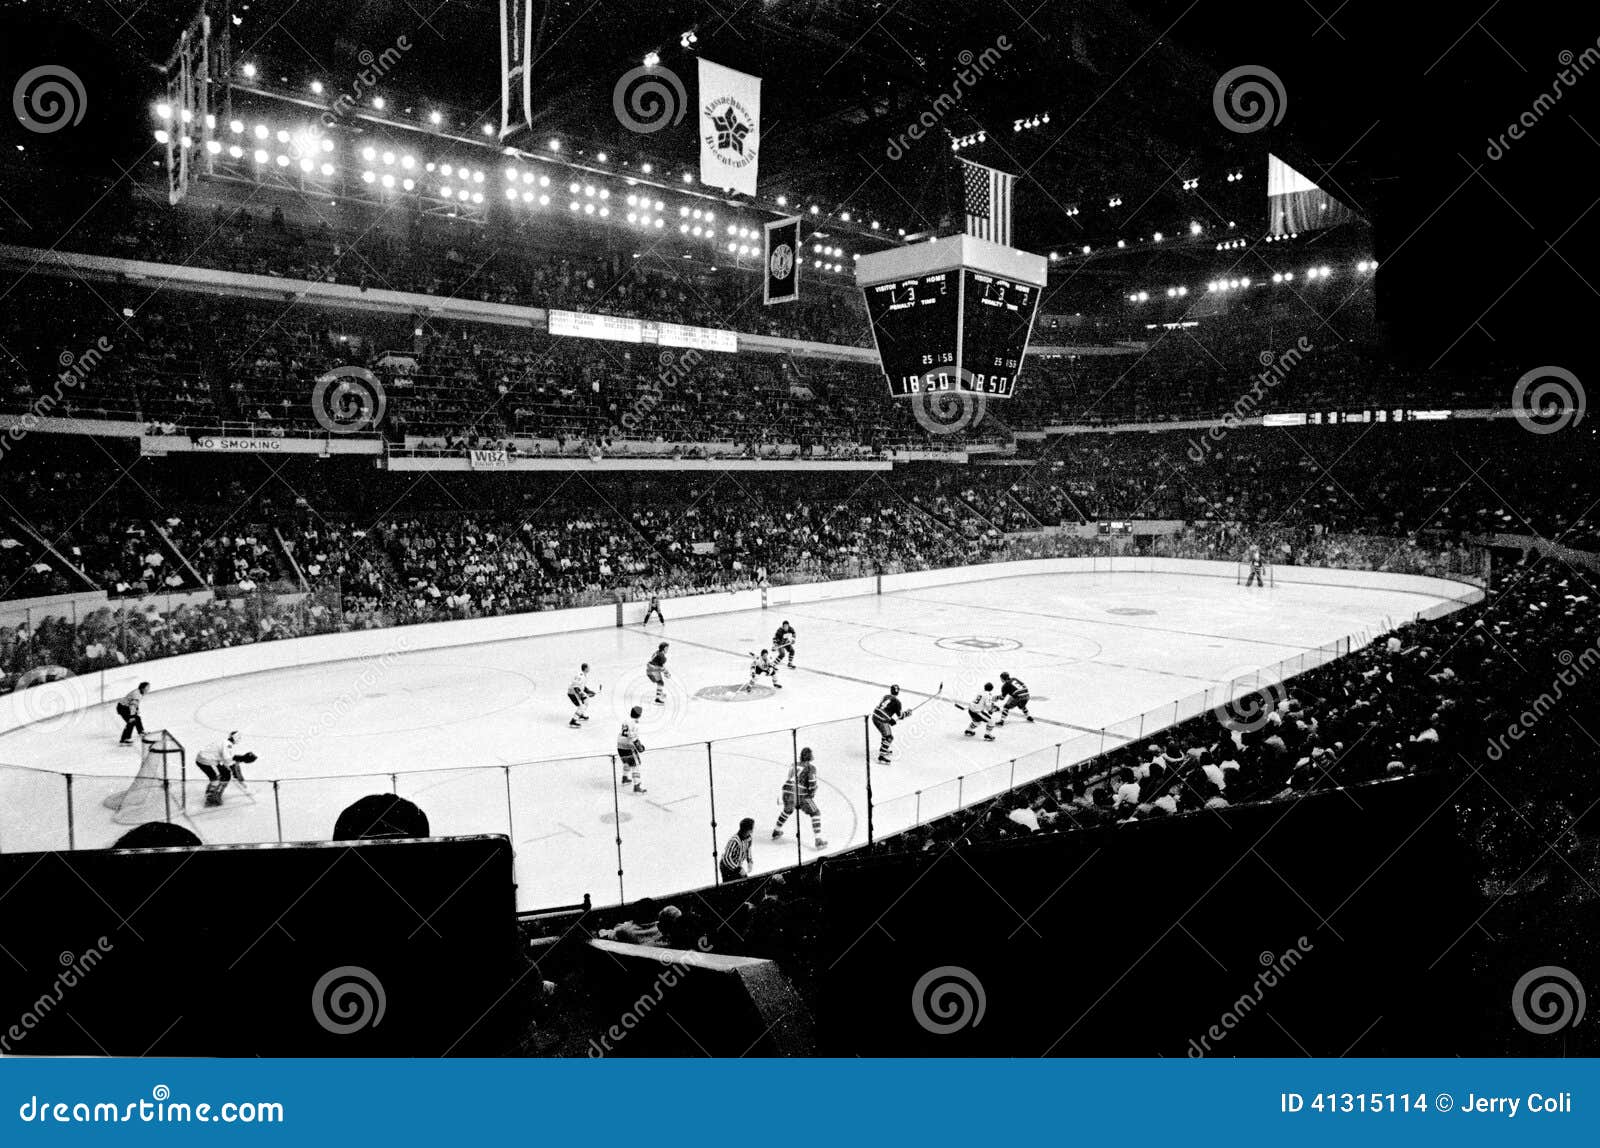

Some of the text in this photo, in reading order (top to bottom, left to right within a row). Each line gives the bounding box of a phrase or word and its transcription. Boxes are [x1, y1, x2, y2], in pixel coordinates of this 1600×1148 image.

[908, 287, 915, 301] 3
[922, 355, 933, 364] 25
[221, 440, 280, 449] SMOKING
[475, 451, 504, 461] WBZ
